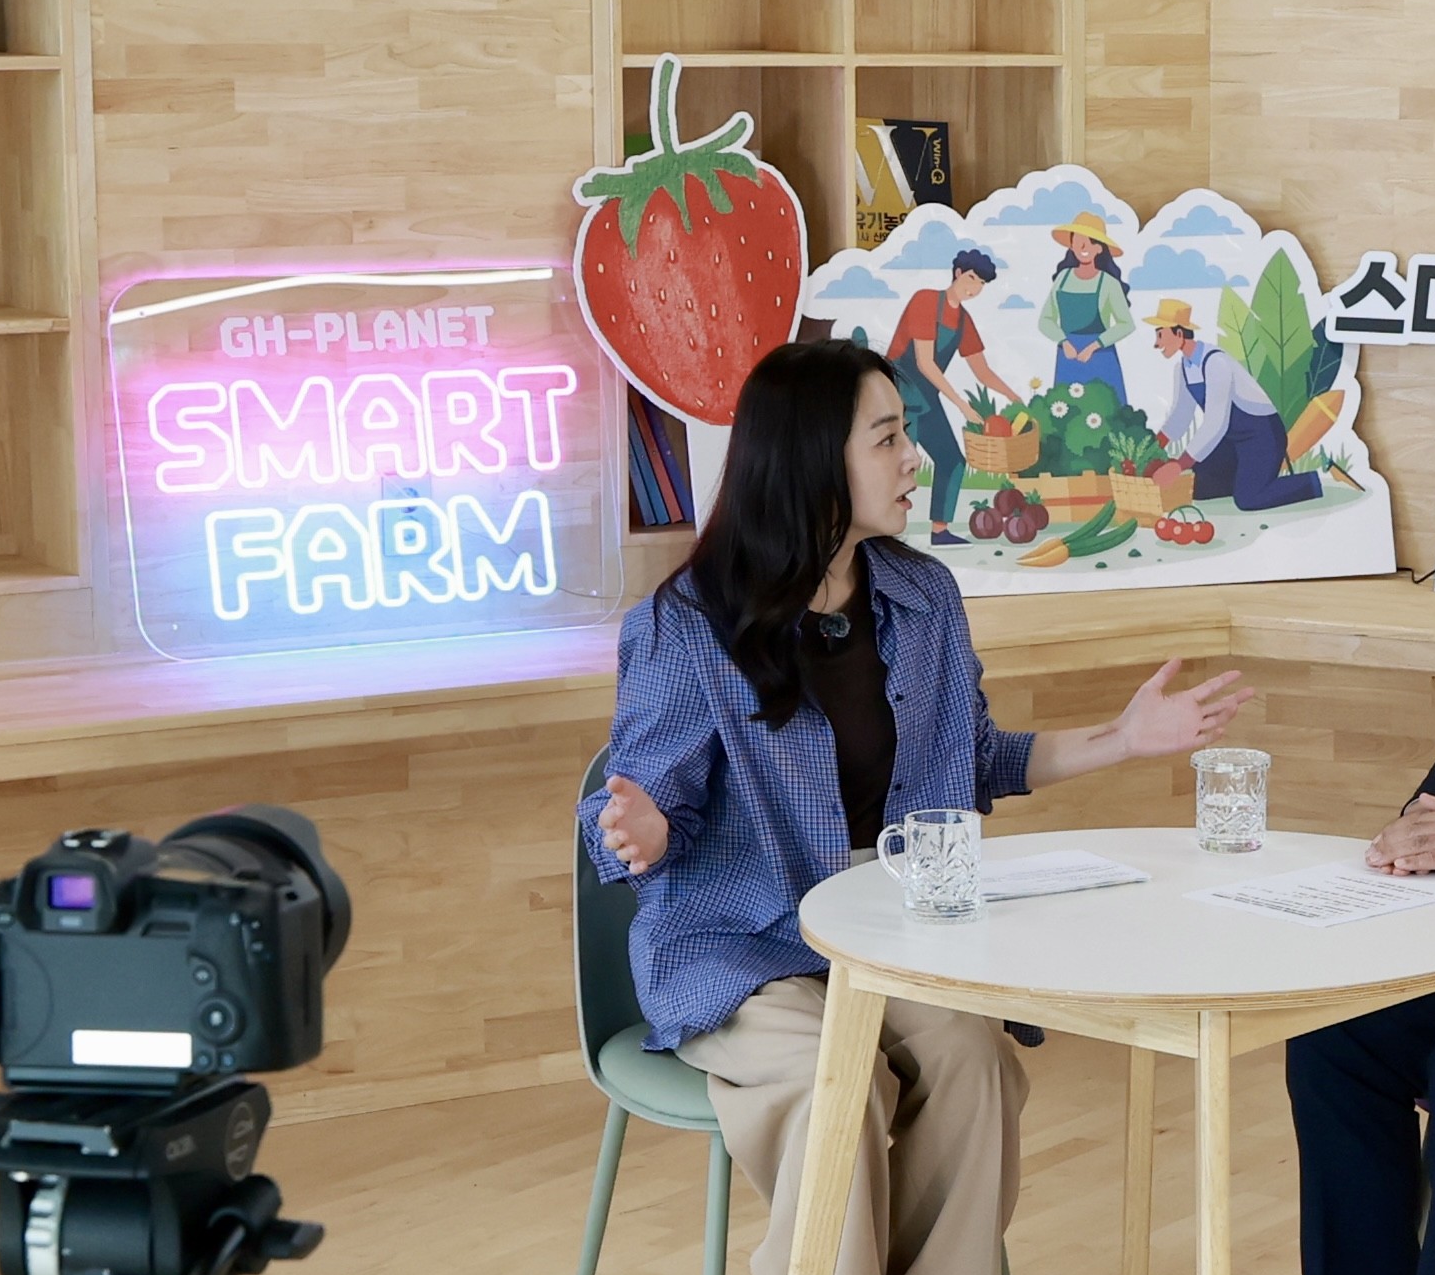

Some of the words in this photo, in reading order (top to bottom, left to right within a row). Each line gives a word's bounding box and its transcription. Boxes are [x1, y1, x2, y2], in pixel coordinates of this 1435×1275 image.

[931, 138, 945, 185] Win-Q
[219, 305, 495, 358] GH-PLANET
[148, 364, 577, 493] SMART
[204, 490, 558, 620] FARM
